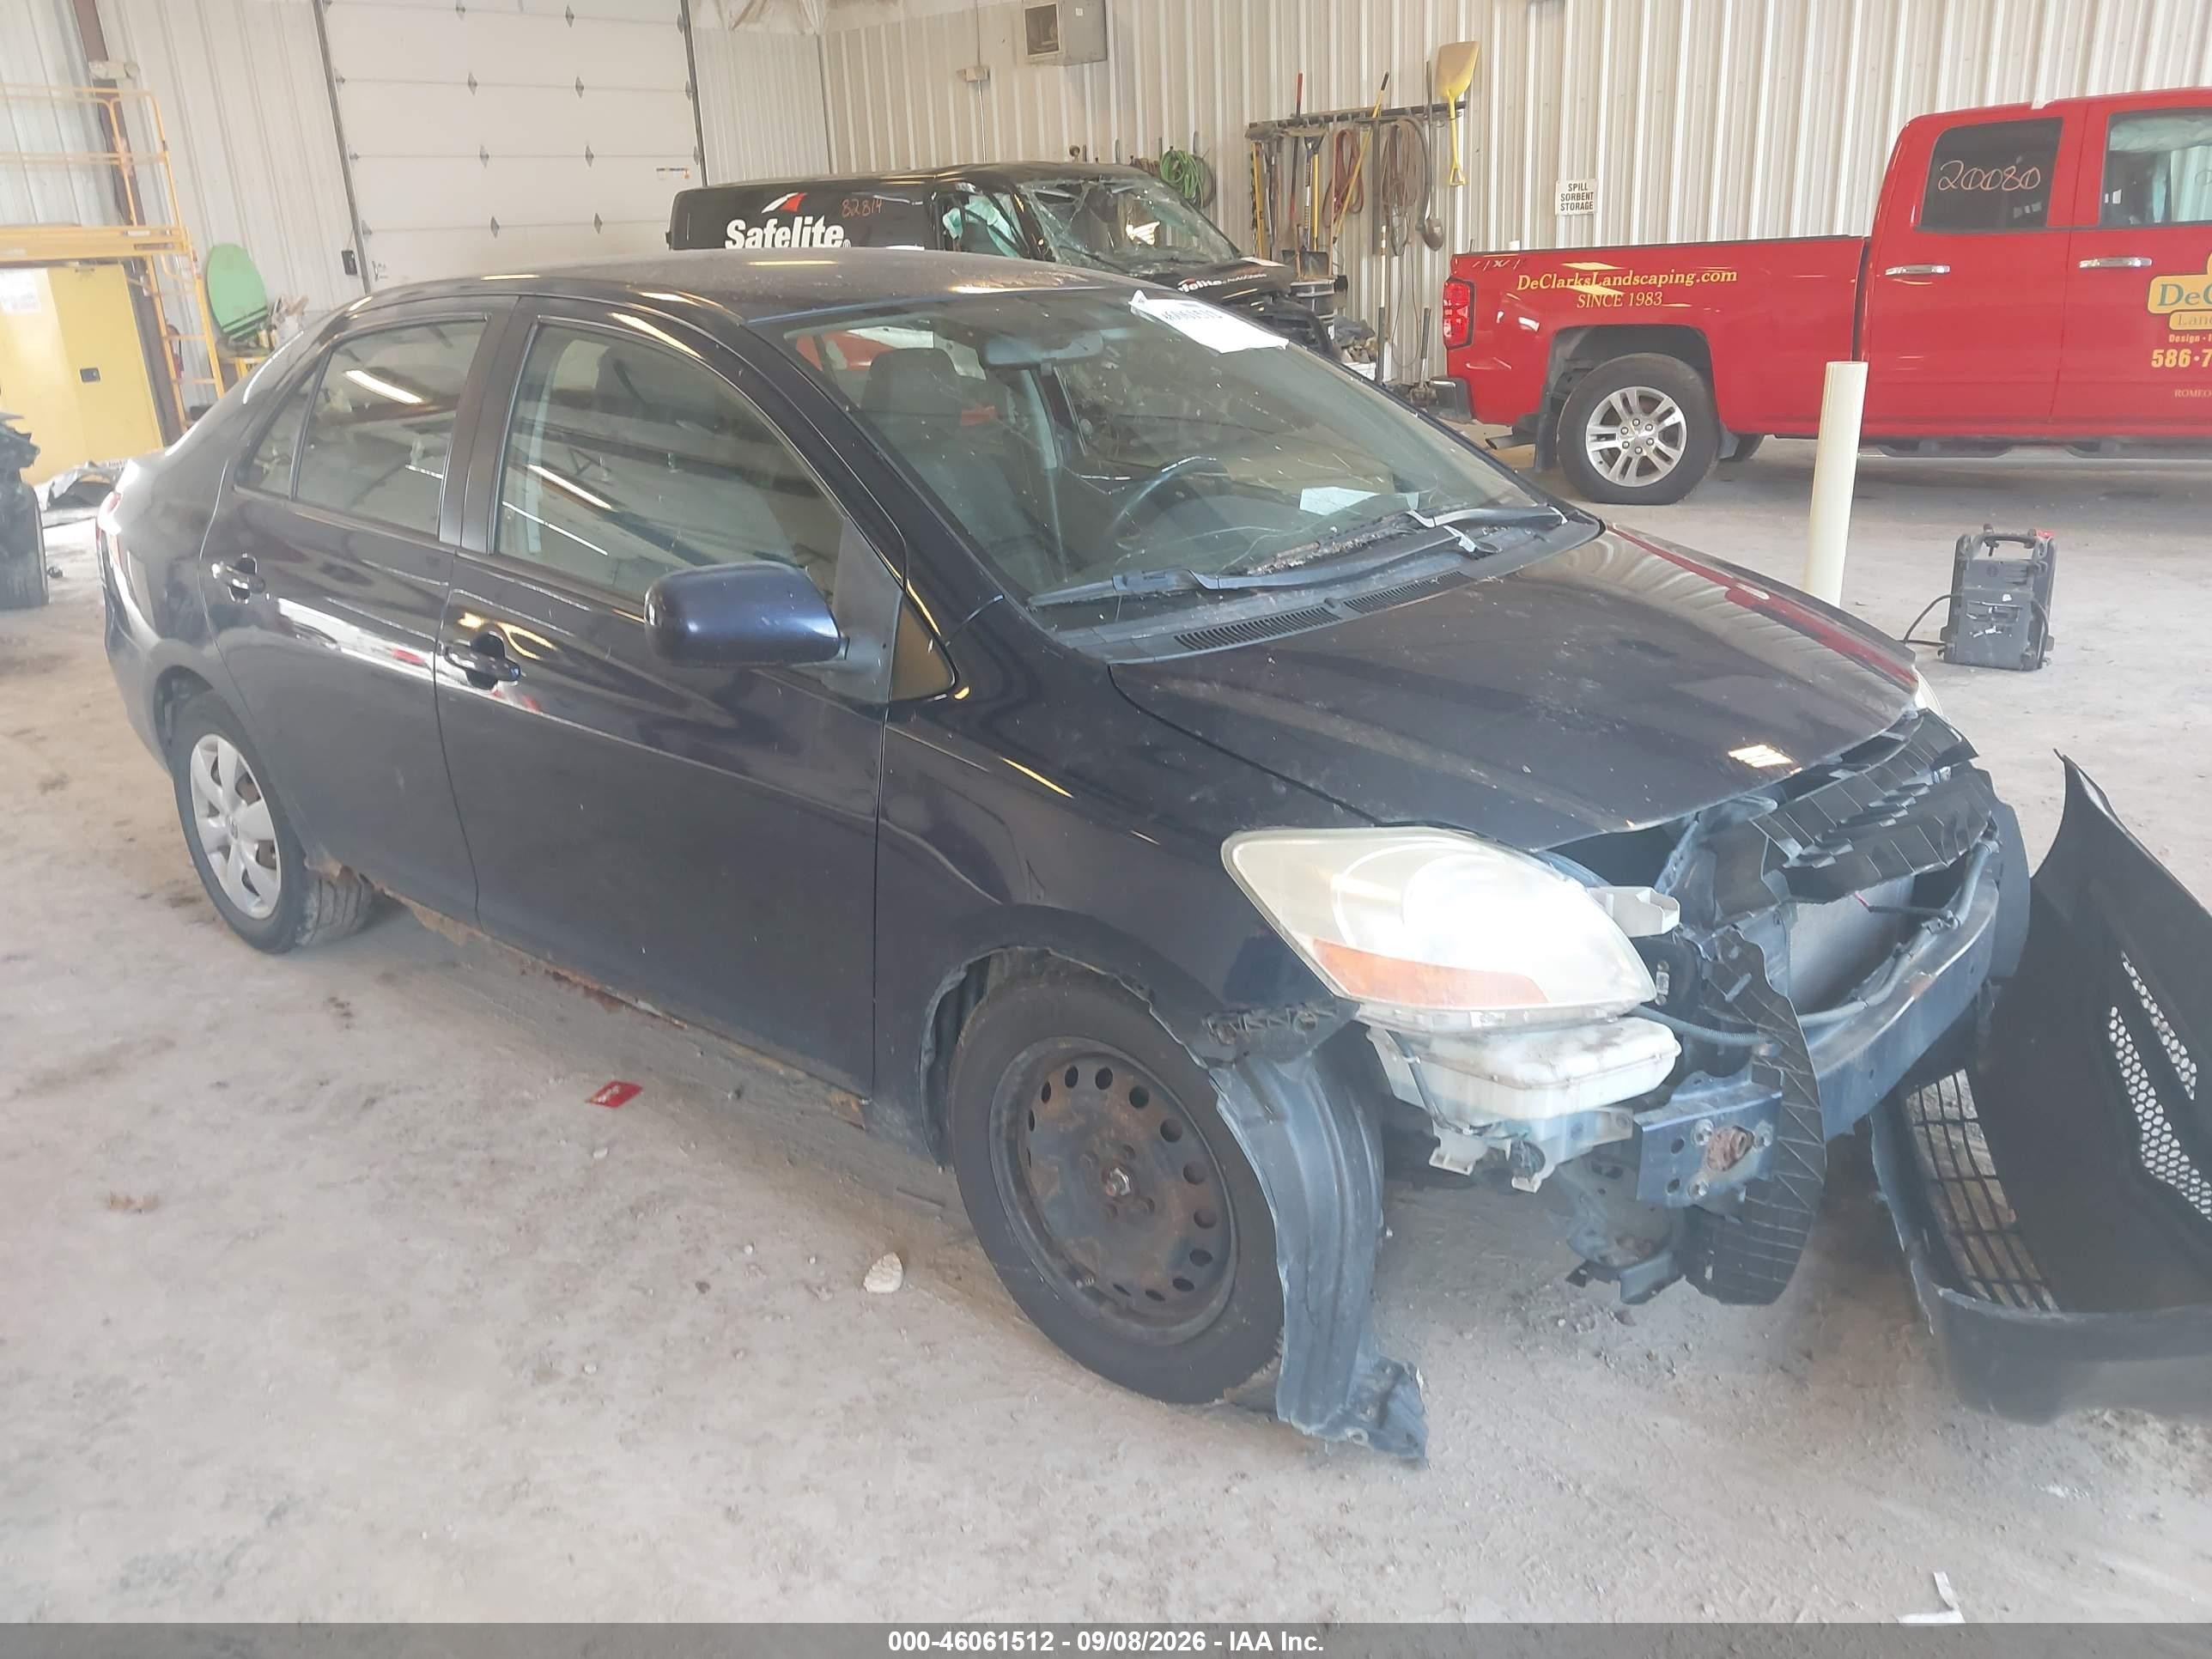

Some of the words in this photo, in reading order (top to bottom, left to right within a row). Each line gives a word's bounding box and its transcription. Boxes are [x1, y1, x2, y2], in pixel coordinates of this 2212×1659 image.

[1938, 160, 2041, 191] 20080
[1568, 182, 1588, 191] SPILL
[1560, 192, 1594, 202] SORBENT
[1560, 201, 1594, 211] STORAGE
[725, 215, 844, 248] Safelite
[1516, 270, 1737, 290] DeClarksLandscaping.com
[1577, 294, 1623, 308] SINCE
[1628, 291, 1663, 307] 1983
[2168, 334, 2200, 343] Design
